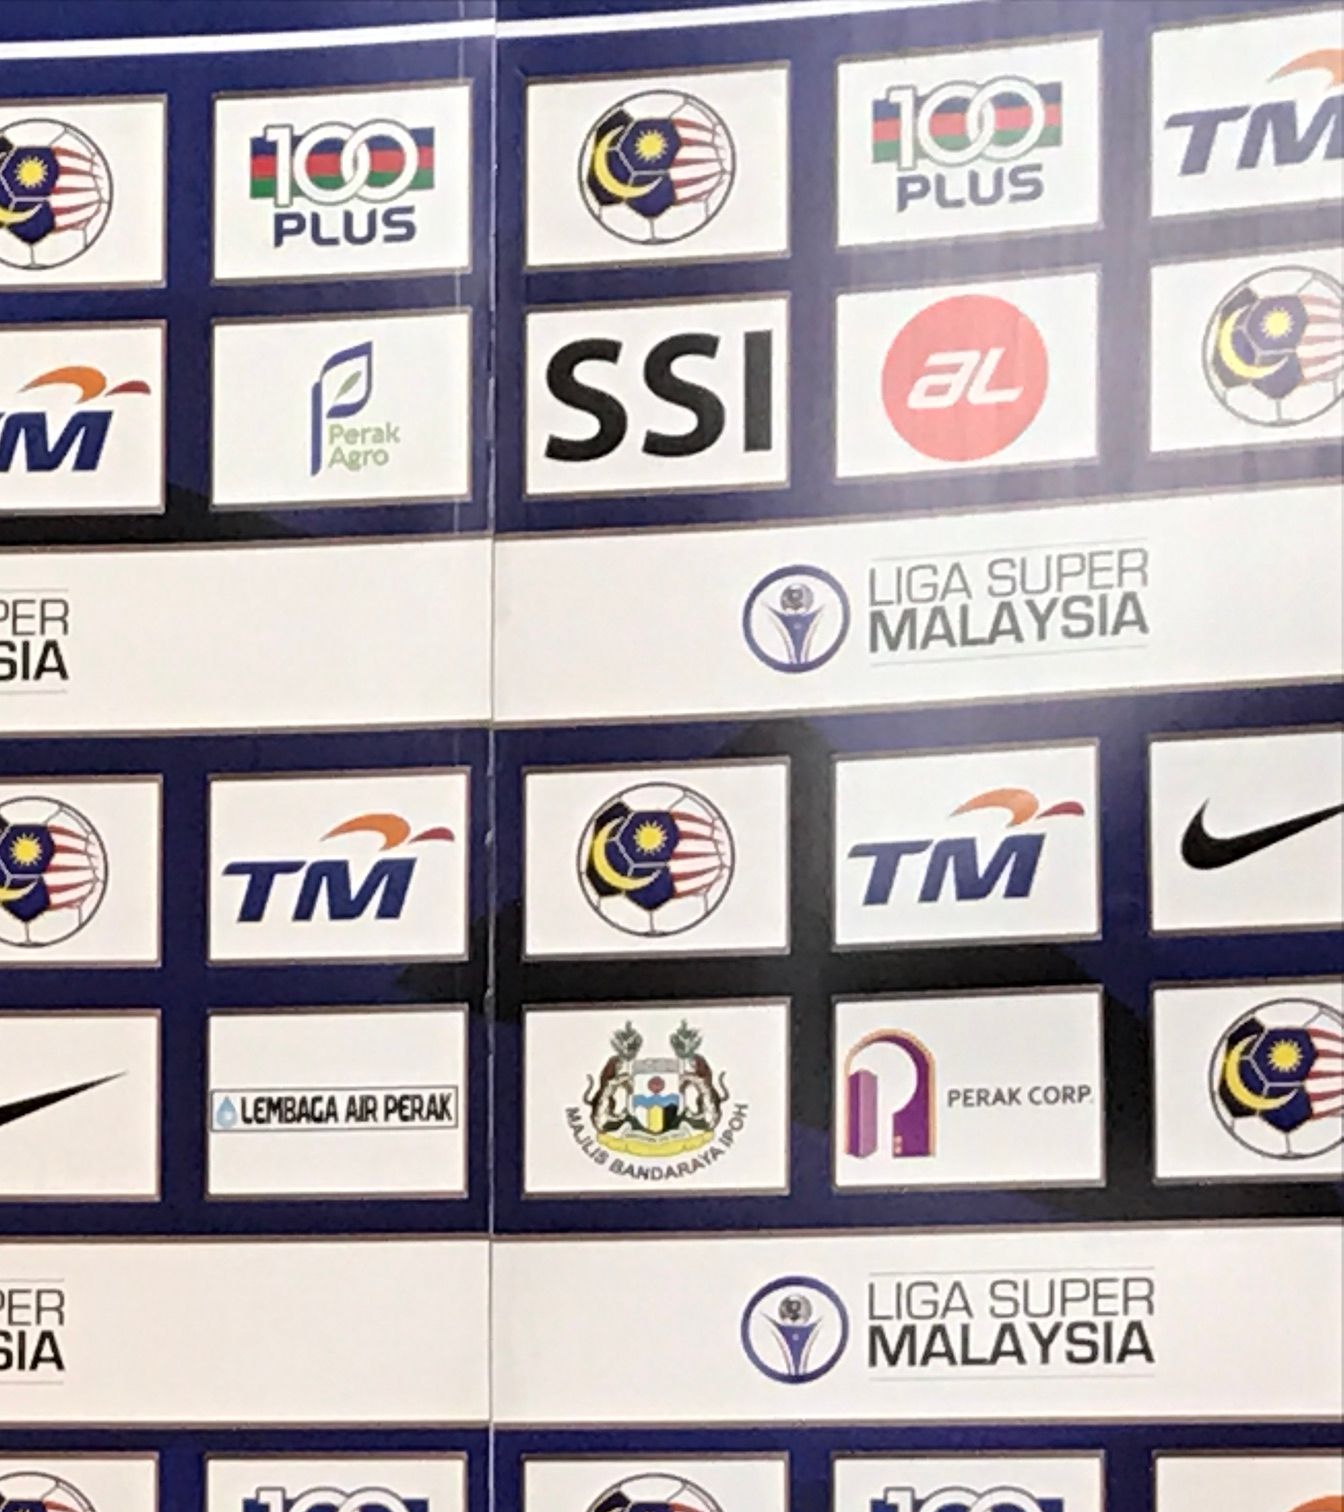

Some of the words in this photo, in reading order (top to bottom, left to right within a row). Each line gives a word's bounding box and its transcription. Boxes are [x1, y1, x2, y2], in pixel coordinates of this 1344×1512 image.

[263, 117, 421, 207] 100
[1164, 93, 1344, 176] TM
[896, 161, 1044, 213] PLUS
[274, 205, 417, 248] PLUS
[544, 330, 772, 463] SSI
[328, 422, 401, 445] Perak
[328, 446, 390, 472] Agro
[869, 563, 973, 607] LIGA
[987, 547, 1149, 599] SUPER
[869, 591, 1150, 654] MALAYSIA
[222, 857, 417, 923] TM
[848, 833, 1046, 906] TM
[240, 1093, 340, 1125] LEMBAGA
[344, 1094, 378, 1123] AIR
[383, 1093, 453, 1123] PERAK
[947, 1087, 1022, 1108] PERAK
[566, 1106, 610, 1165] MAJLIS
[609, 1146, 725, 1181] BANDARAYA
[719, 1103, 748, 1147] IPOH
[868, 1281, 974, 1321] LIGA
[989, 1276, 1155, 1319] SUPER
[868, 1317, 1155, 1368] MALAYSIA
